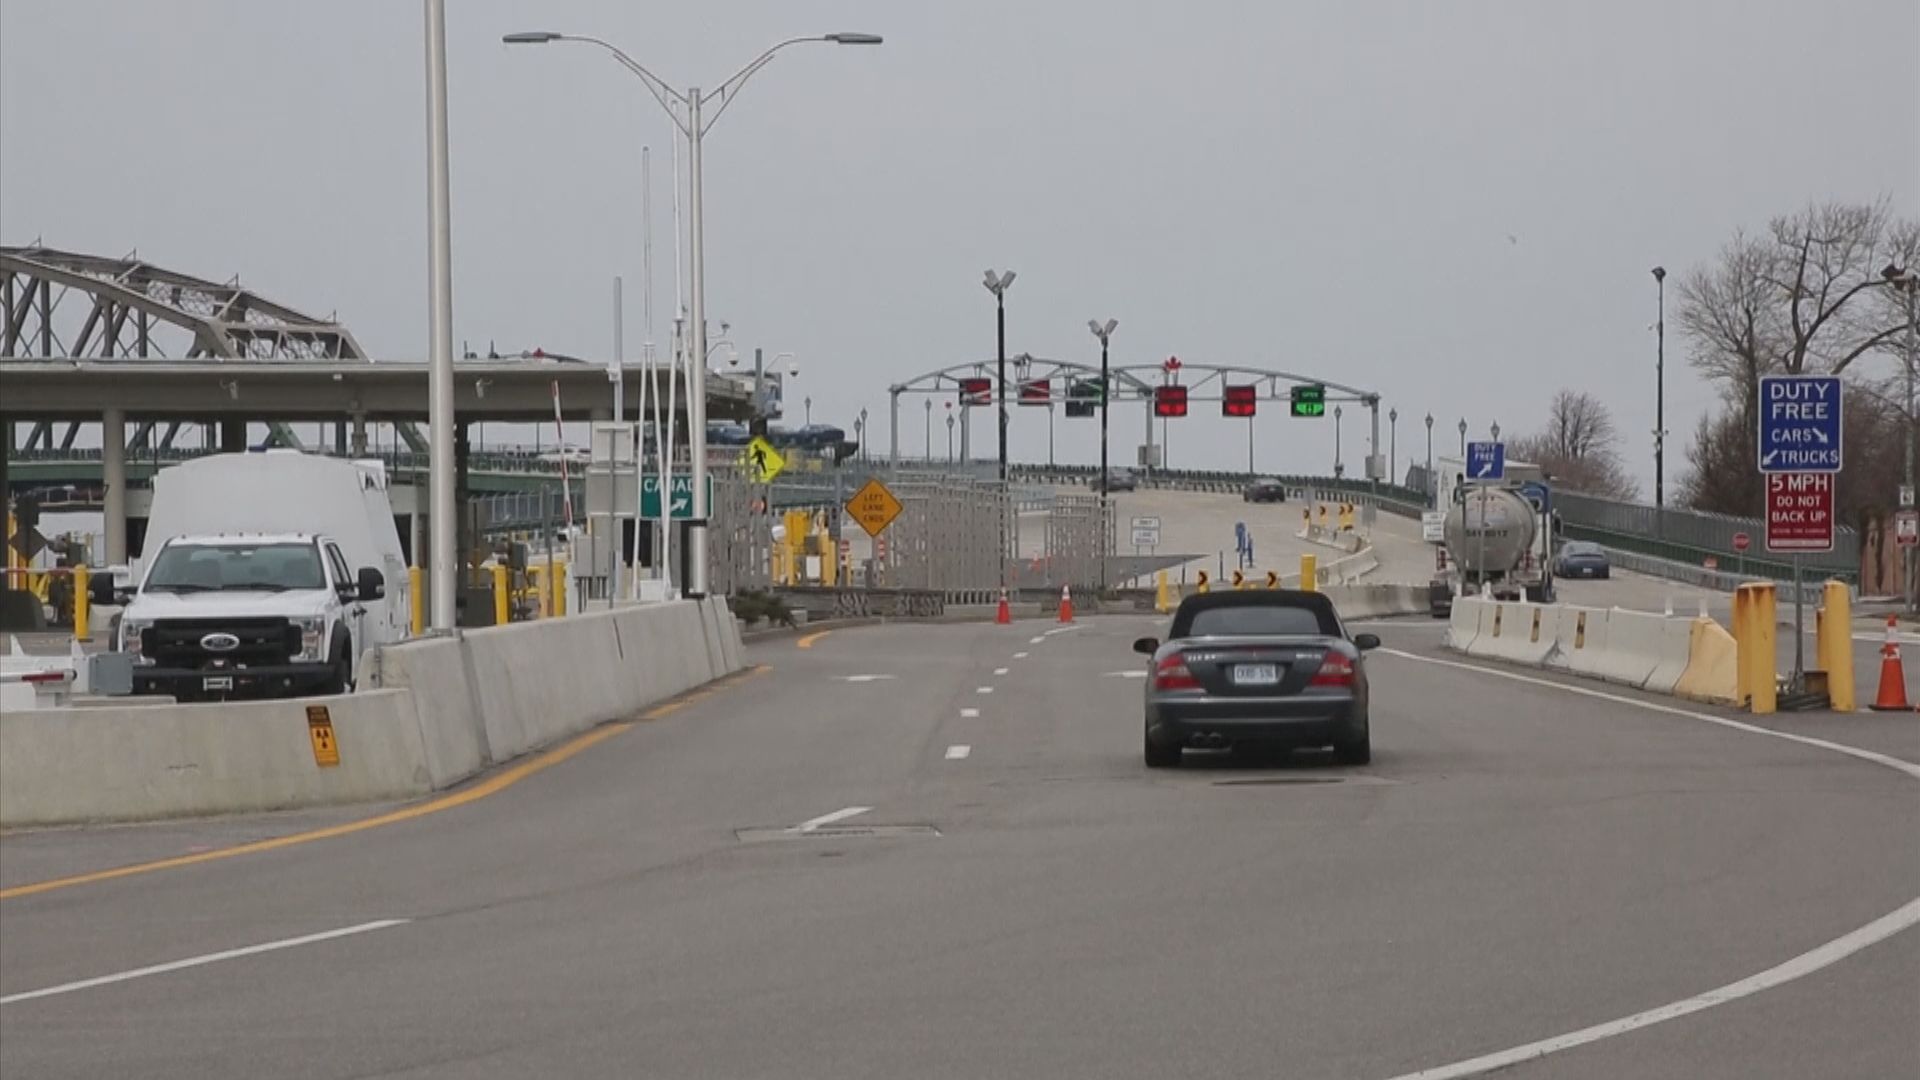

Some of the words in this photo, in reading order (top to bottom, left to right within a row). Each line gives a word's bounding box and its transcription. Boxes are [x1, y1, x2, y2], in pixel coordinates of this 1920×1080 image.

[1770, 382, 1830, 399] DUTY
[1772, 402, 1829, 420] FREE
[1771, 427, 1812, 443] CARS
[1780, 448, 1838, 464] TRUCKS
[643, 478, 694, 493] CAA
[1771, 474, 1784, 492] 5
[1787, 474, 1828, 492] MPH
[1776, 495, 1793, 507] DO
[1798, 495, 1821, 507] NOT
[1772, 511, 1805, 523] BACK
[1810, 511, 1827, 523] UP
